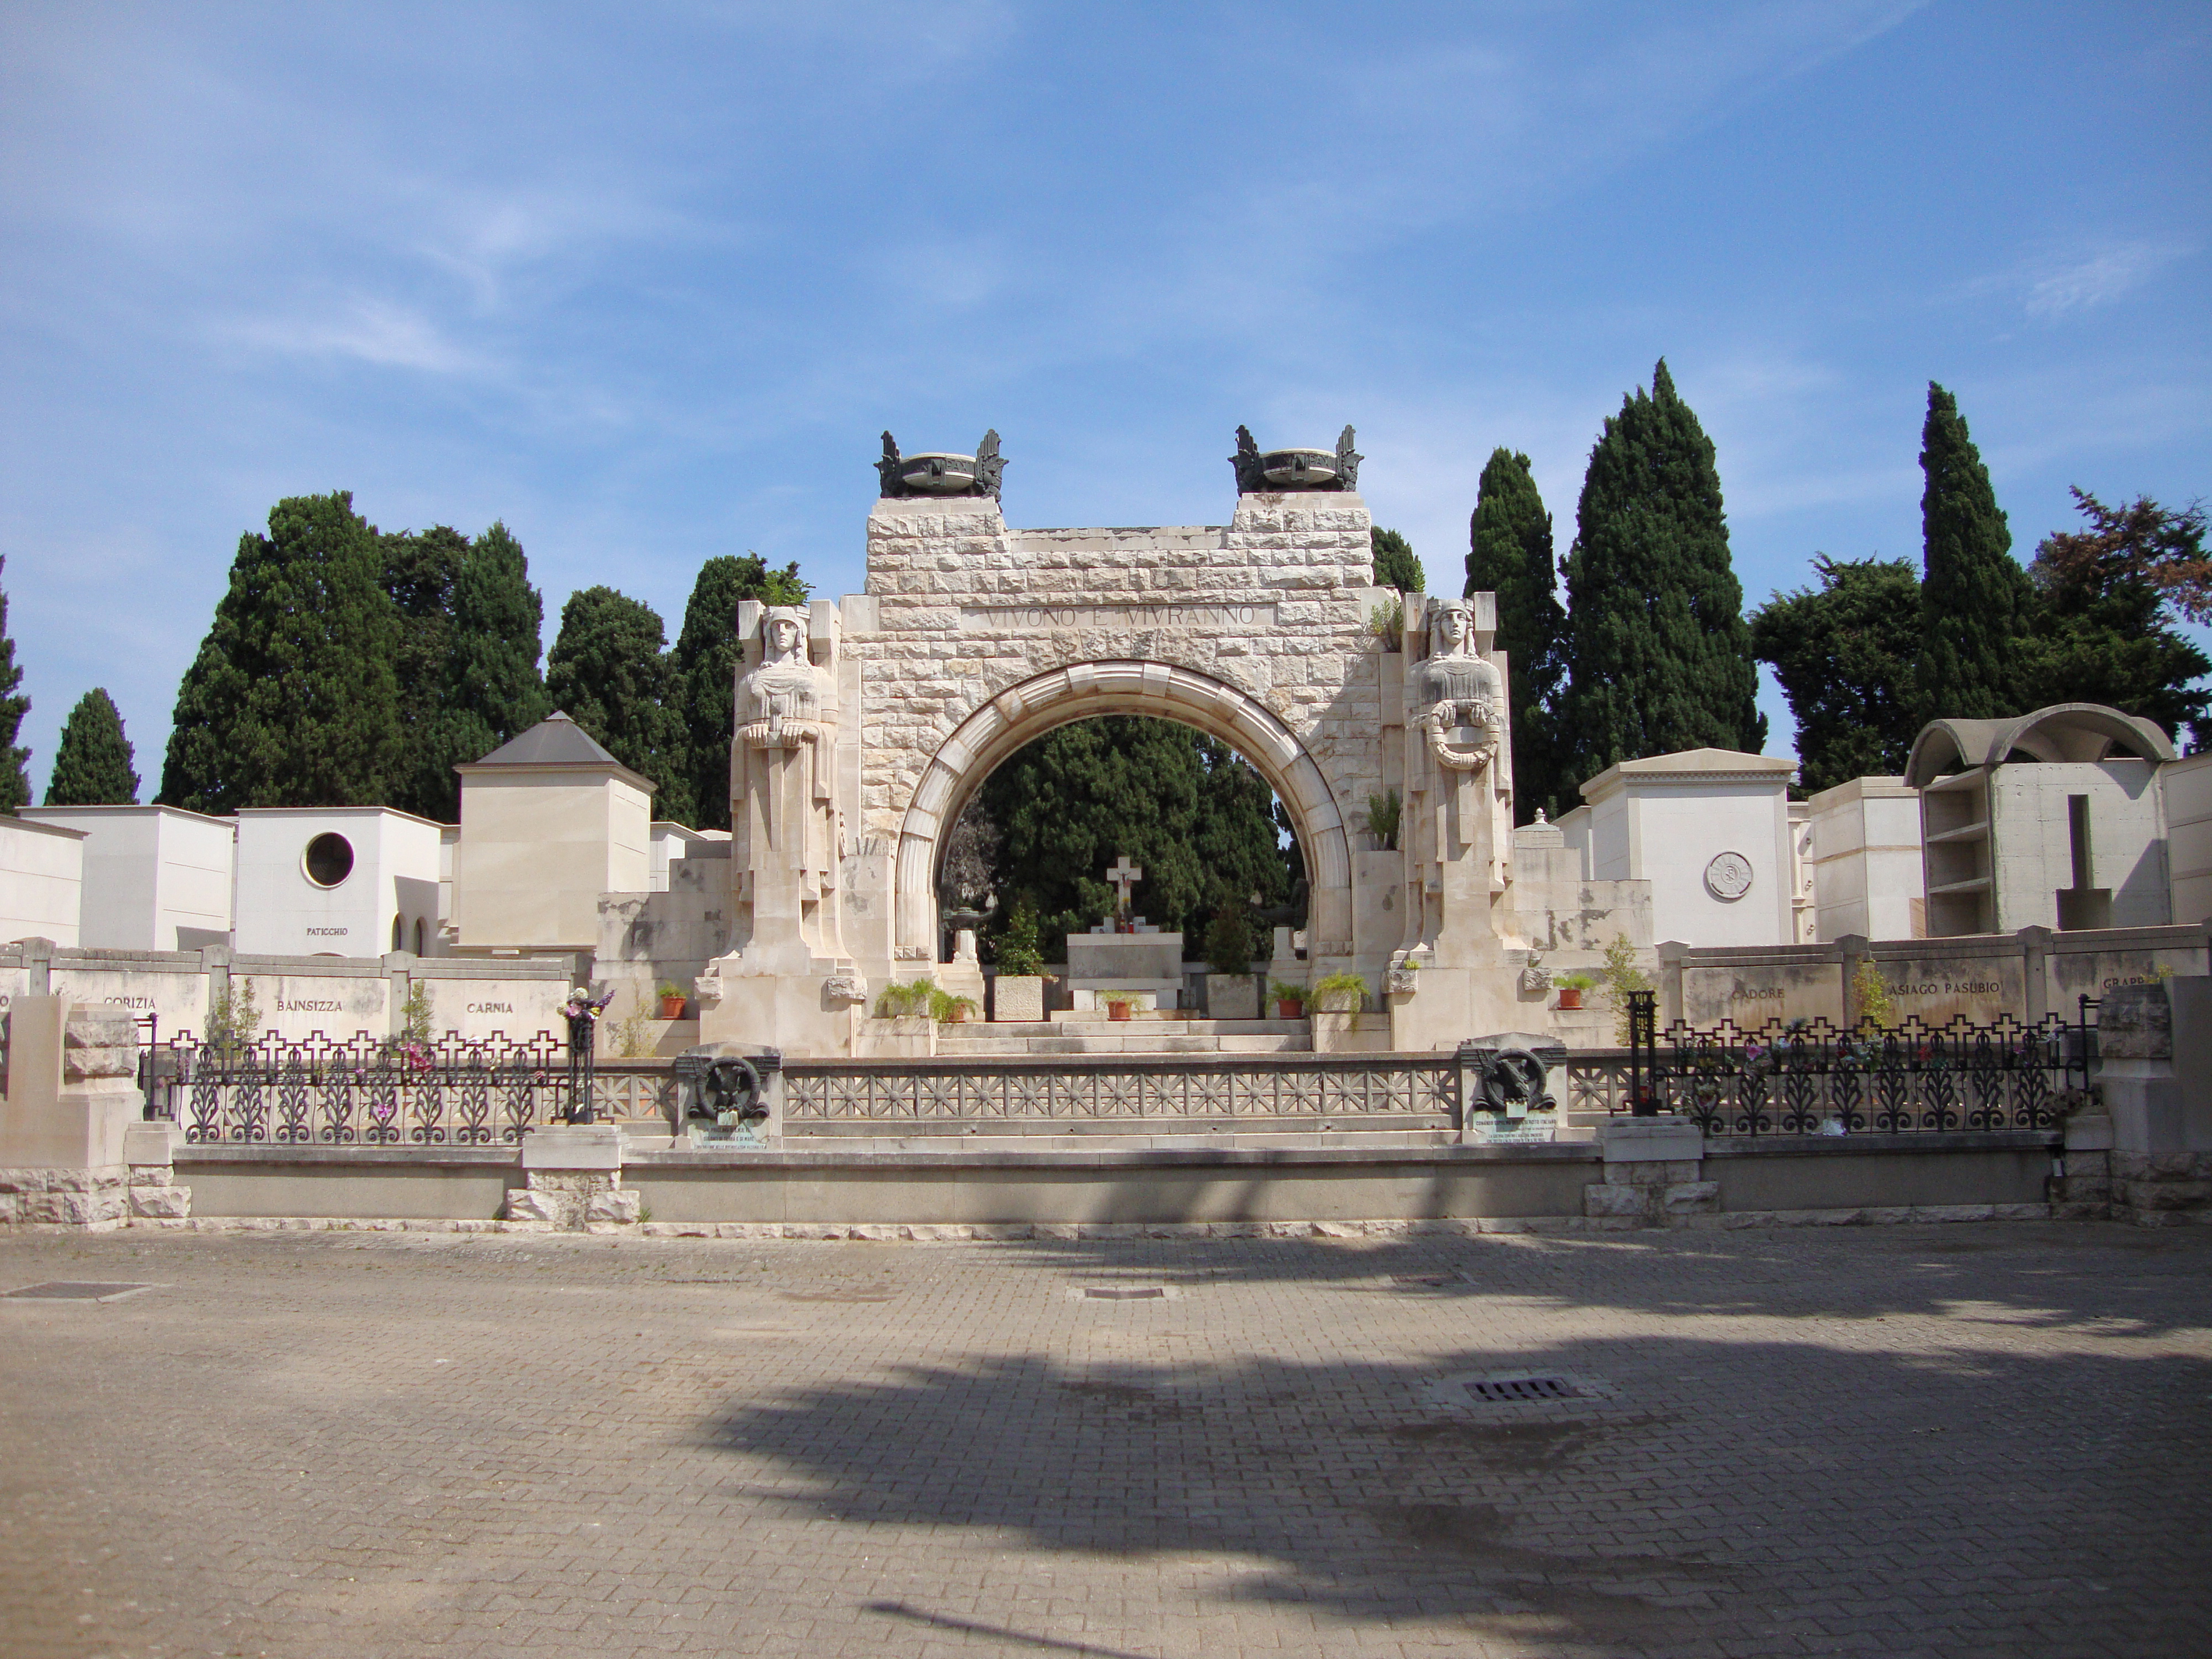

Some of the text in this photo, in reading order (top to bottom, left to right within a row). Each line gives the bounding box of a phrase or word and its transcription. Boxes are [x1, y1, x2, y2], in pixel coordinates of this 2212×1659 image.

[985, 605, 1255, 627] VIVONO E VIVRANNO
[307, 927, 349, 936] PATICCHIO
[1889, 982, 2000, 996] ASIAGO PASUBIO
[2103, 976, 2145, 989] GRAPP
[1731, 987, 1785, 1000] CADORE
[277, 1000, 343, 1012] BAINSIZZA
[467, 1002, 513, 1014] CARNIA
